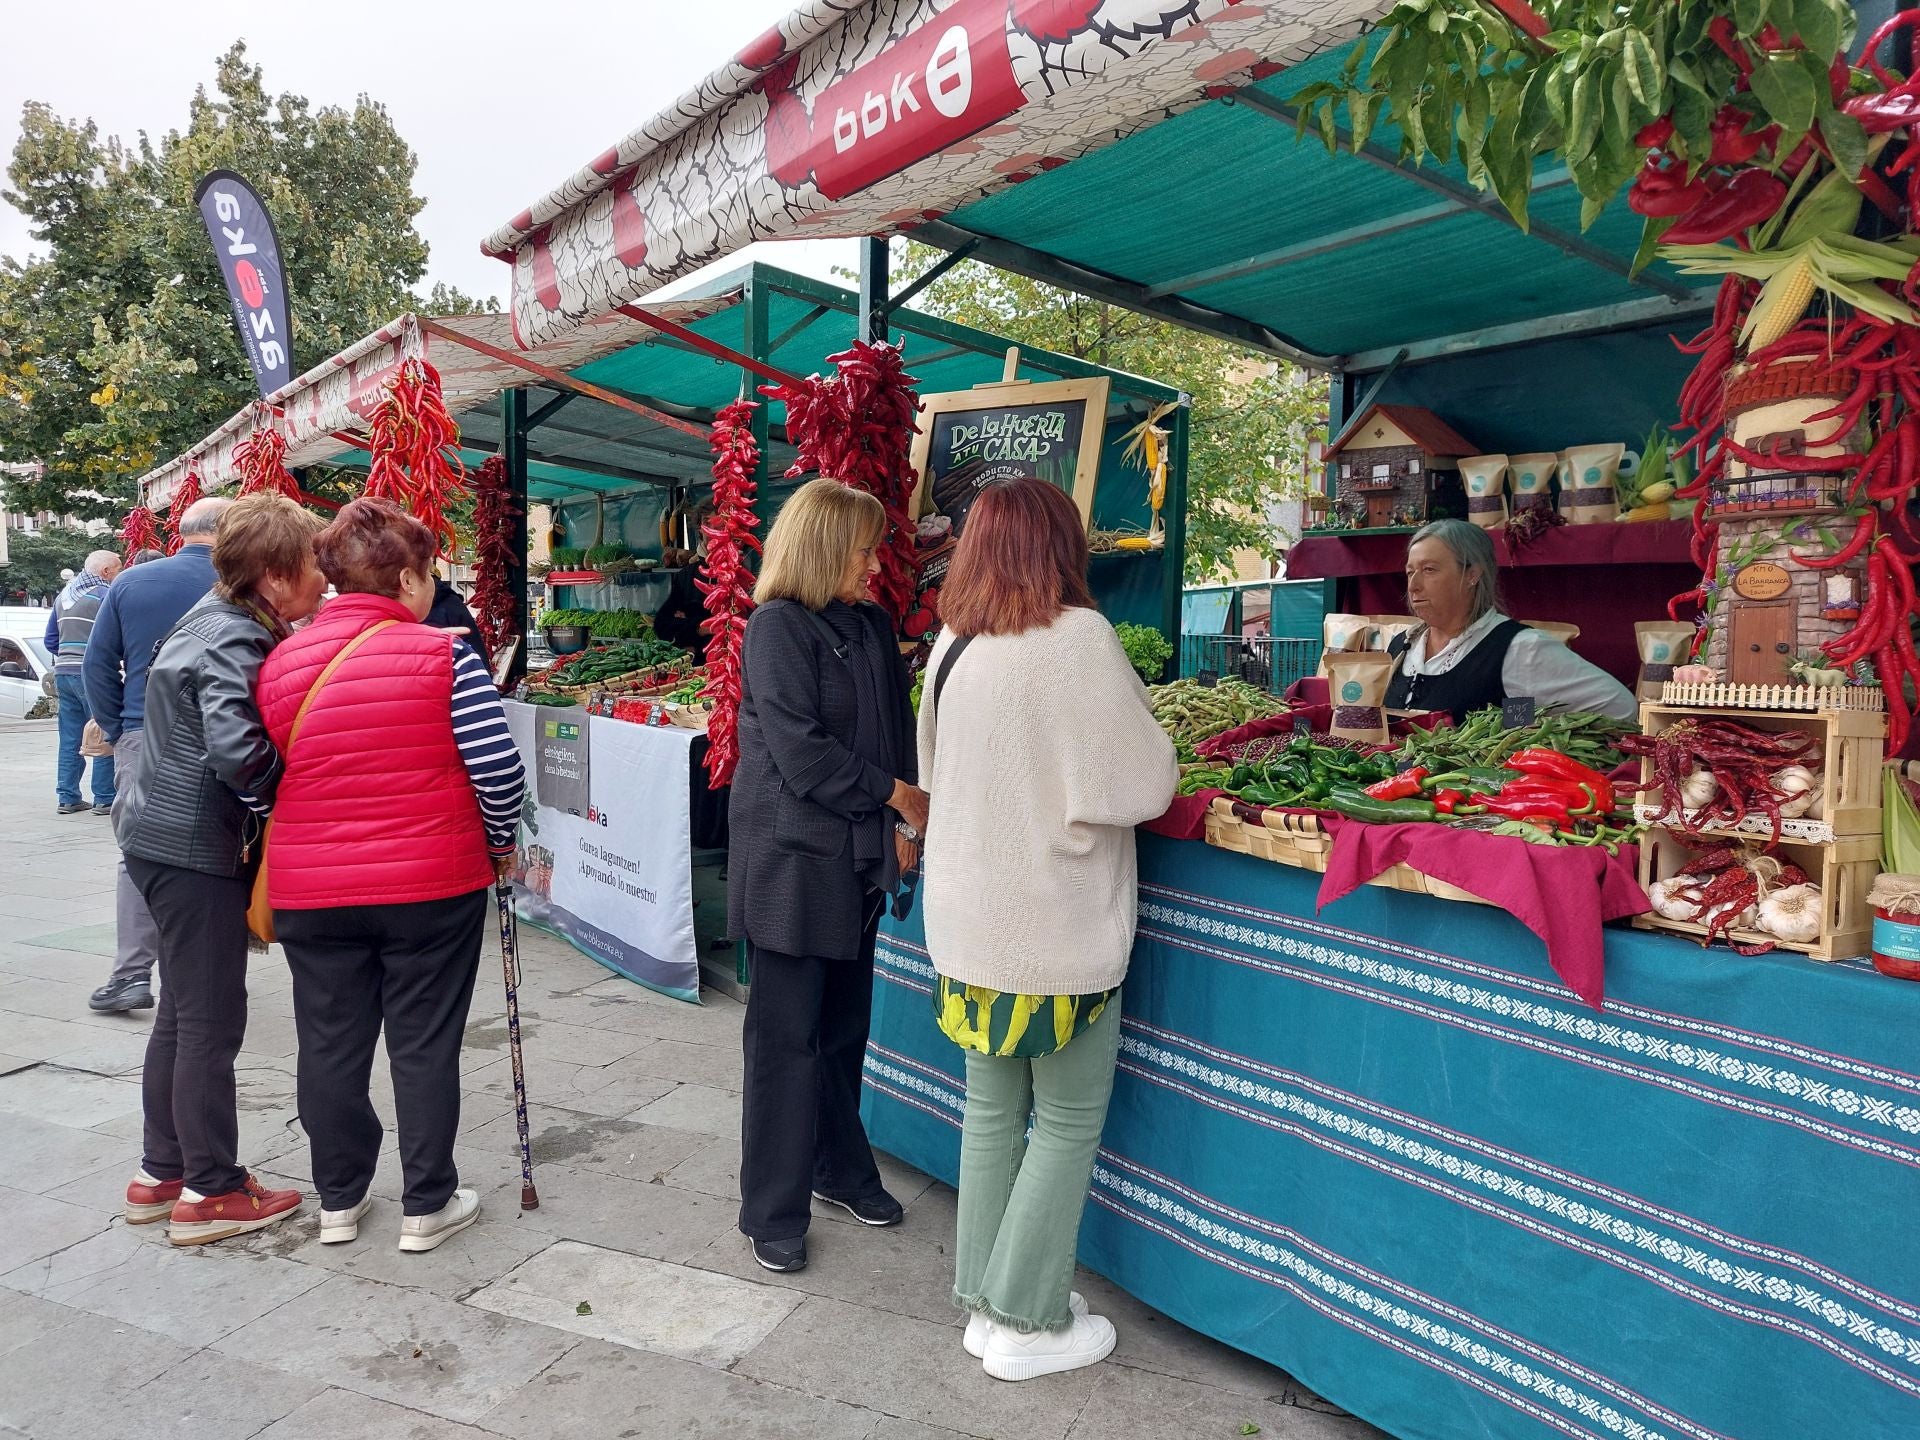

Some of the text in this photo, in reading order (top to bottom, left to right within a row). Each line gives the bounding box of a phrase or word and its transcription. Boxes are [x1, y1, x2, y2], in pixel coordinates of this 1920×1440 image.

[833, 71, 921, 154] bbk
[983, 437, 1050, 462] CASA
[971, 466, 1012, 486] PRODUCTO
[579, 837, 641, 874] Gurea laguntzen!
[578, 860, 658, 904] ¡Apoyando lo nuestro!
